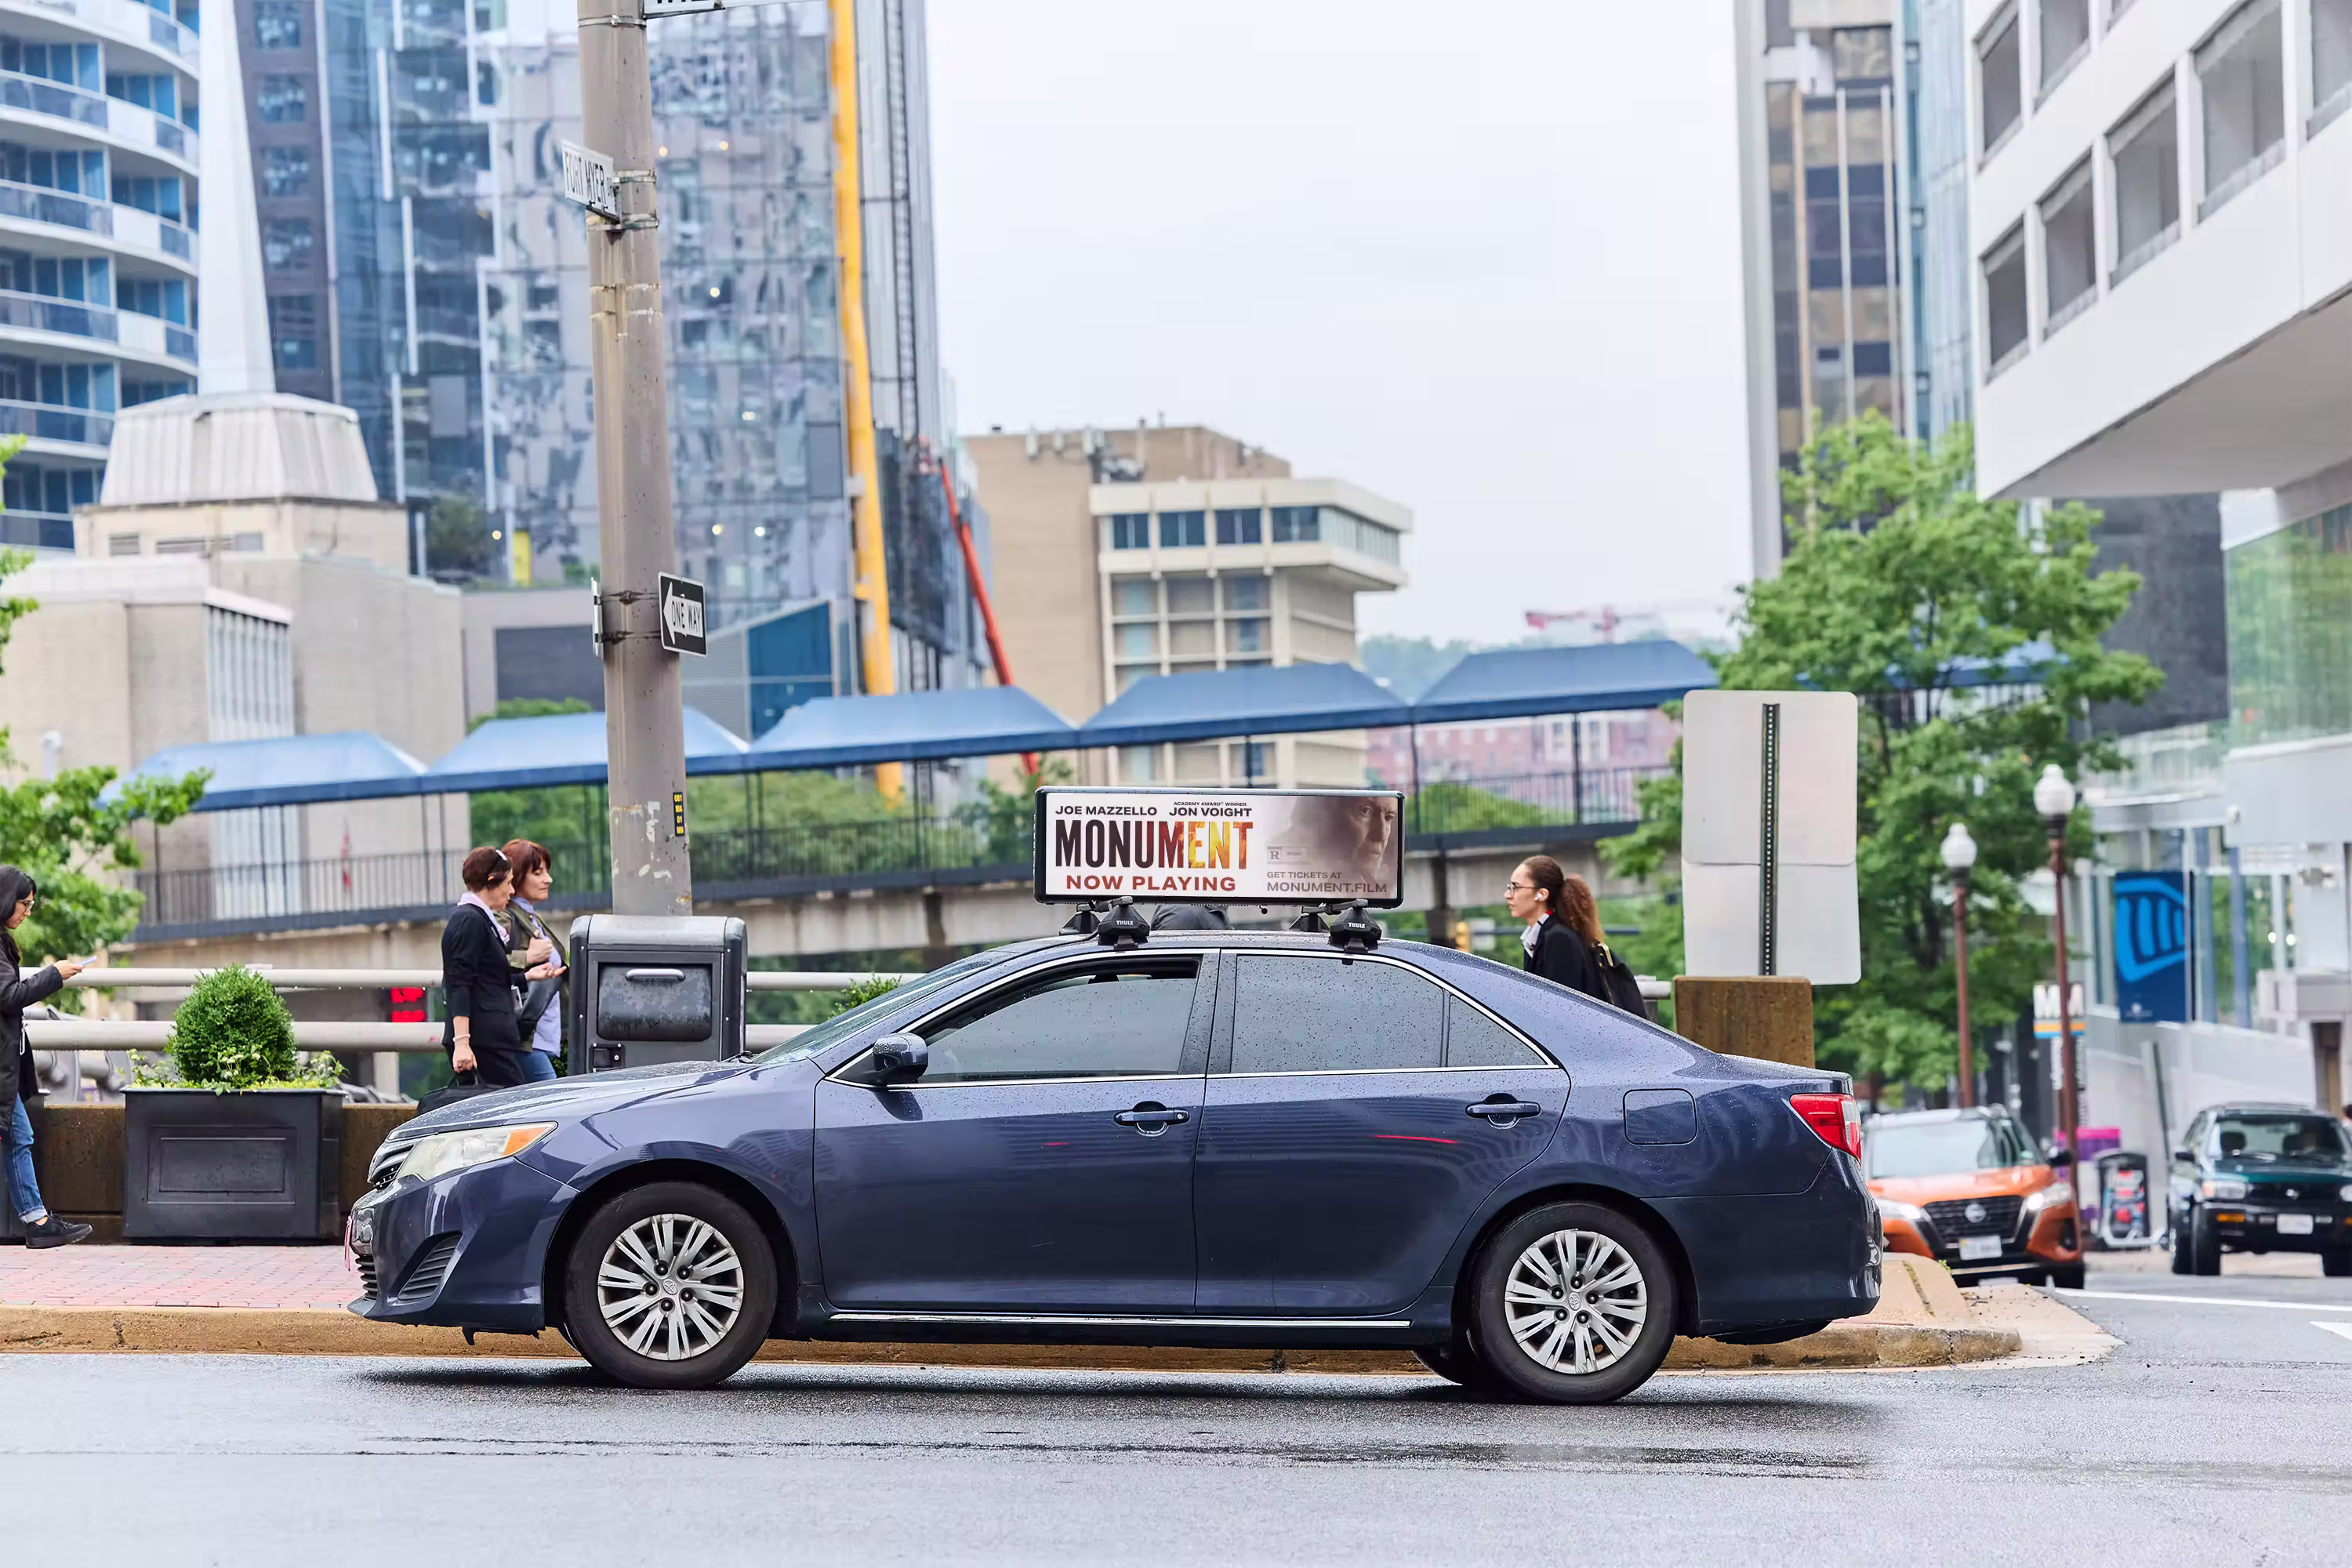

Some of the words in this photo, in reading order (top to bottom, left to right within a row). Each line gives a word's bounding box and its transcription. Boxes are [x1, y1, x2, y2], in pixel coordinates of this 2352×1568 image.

[564, 151, 583, 196] FORT
[584, 159, 606, 205] MYER
[671, 601, 685, 629] ONE
[688, 604, 701, 633] WAY
[1055, 806, 1083, 815] JOE
[1086, 806, 1157, 816] MAZZELLO
[1169, 807, 1197, 816] JON
[1201, 808, 1252, 817] VOIGHT
[1055, 819, 1254, 869] MONUMENT
[1066, 875, 1123, 890] NOW
[1132, 876, 1236, 891] PLAYING
[1267, 881, 1387, 893] MONUMENT.FILM
